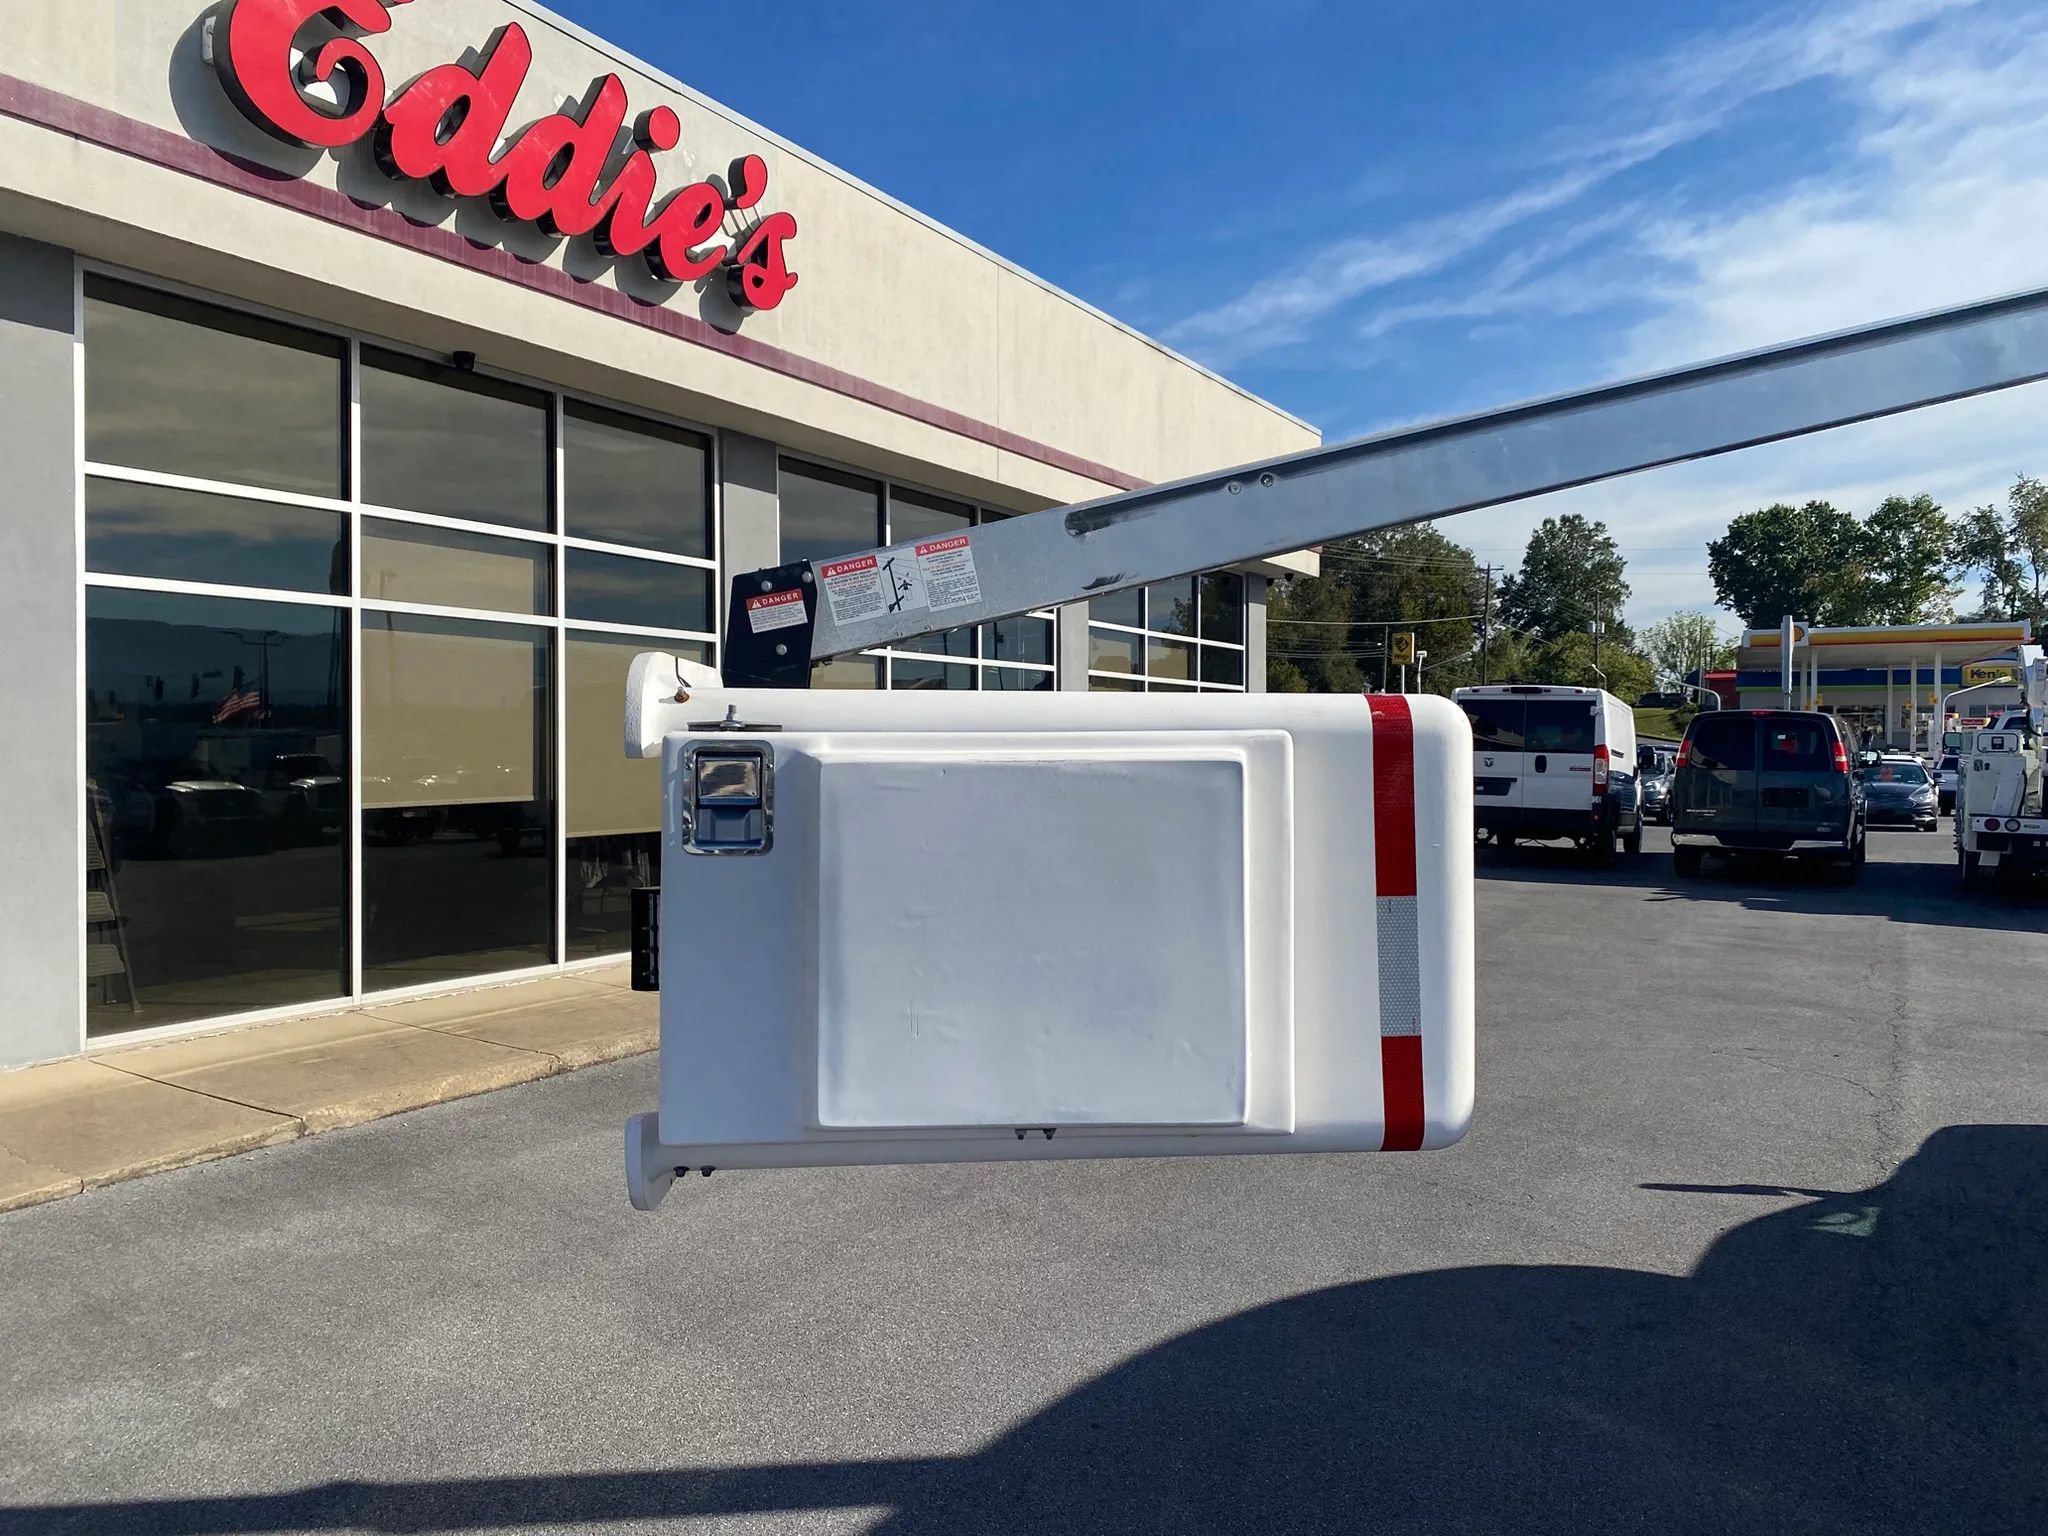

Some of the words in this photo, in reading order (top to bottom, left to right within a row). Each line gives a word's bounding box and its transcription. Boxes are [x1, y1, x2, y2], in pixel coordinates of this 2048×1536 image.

[220, 0, 798, 310] Eddie's
[929, 538, 966, 552] DANGER
[837, 559, 874, 573] DANGER
[762, 592, 799, 605] DANGER
